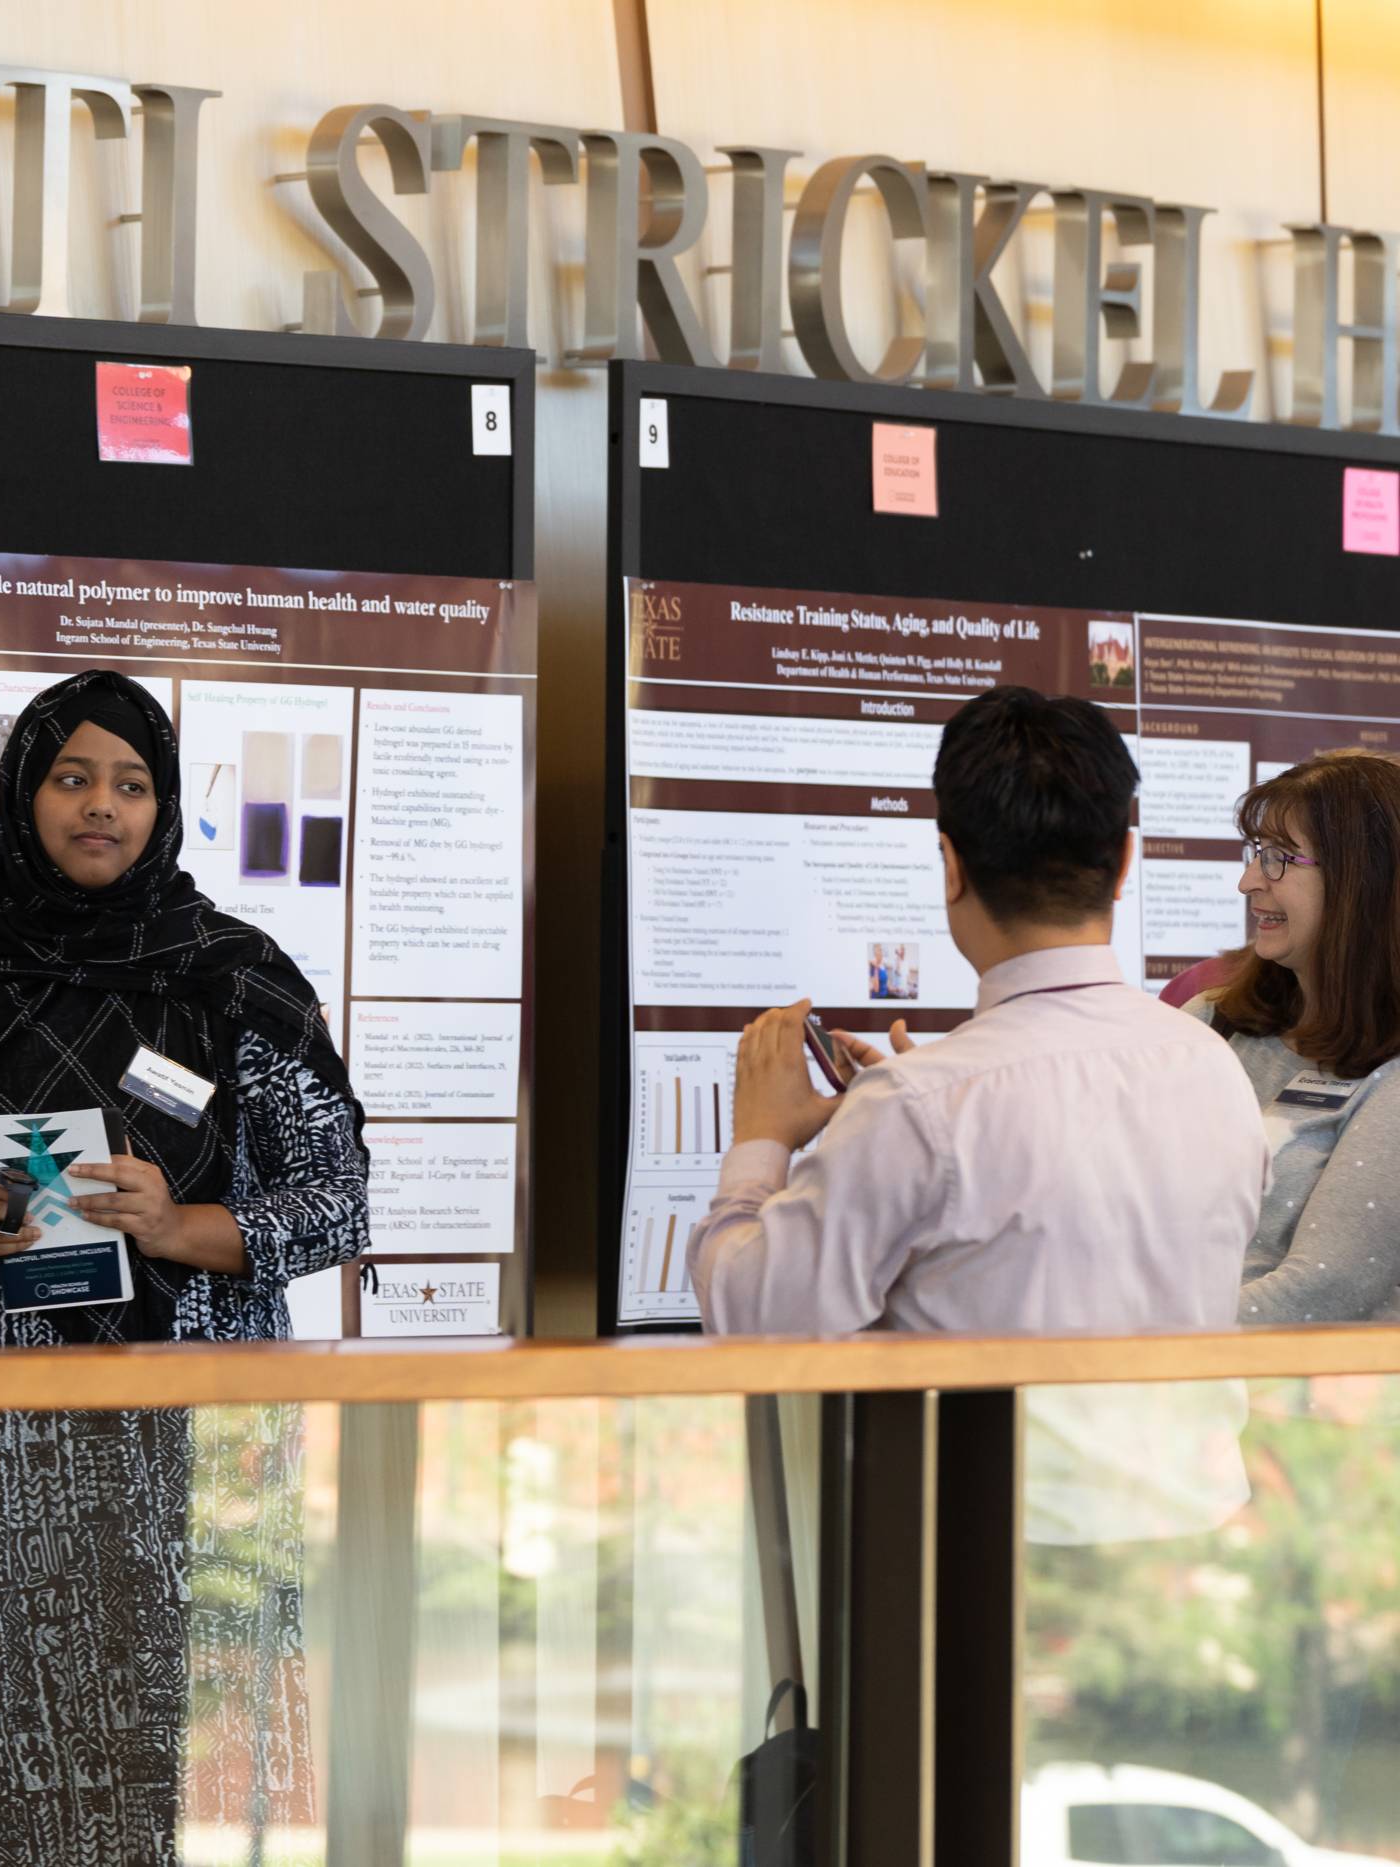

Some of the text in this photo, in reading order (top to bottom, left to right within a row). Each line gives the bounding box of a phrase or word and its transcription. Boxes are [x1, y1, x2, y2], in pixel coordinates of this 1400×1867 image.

[302, 103, 1255, 421] STRICKEL
[112, 386, 166, 398] COLLEGE OF
[116, 401, 154, 411] SCIENCE
[487, 412, 496, 430] 8
[650, 425, 657, 443] 9
[16, 579, 74, 597] natural
[78, 580, 150, 605] polymer
[154, 587, 171, 601] to
[176, 584, 242, 609] improve
[246, 587, 304, 608] human
[308, 591, 357, 611] health
[361, 595, 390, 613] and
[394, 601, 435, 615] water
[439, 600, 489, 624] quality
[60, 615, 73, 625] Dr.
[75, 616, 103, 628] Sujata
[105, 617, 137, 628] Mandal
[140, 620, 190, 633] (presenter),
[192, 621, 205, 631] Dr.
[246, 624, 277, 638] Hwang
[730, 601, 793, 624] Resistance
[796, 605, 849, 631] Training
[851, 609, 890, 631] Status,
[932, 616, 953, 634] and
[956, 616, 1000, 641] Quality
[1003, 619, 1015, 637] of
[1017, 620, 1039, 639] Life
[56, 631, 281, 654] Ingram School of Engineering, Texas State University
[861, 700, 914, 716] Introduction
[871, 797, 908, 811] Methods
[439, 1282, 485, 1298] STATE
[389, 1309, 468, 1324] UNIVERSITY
